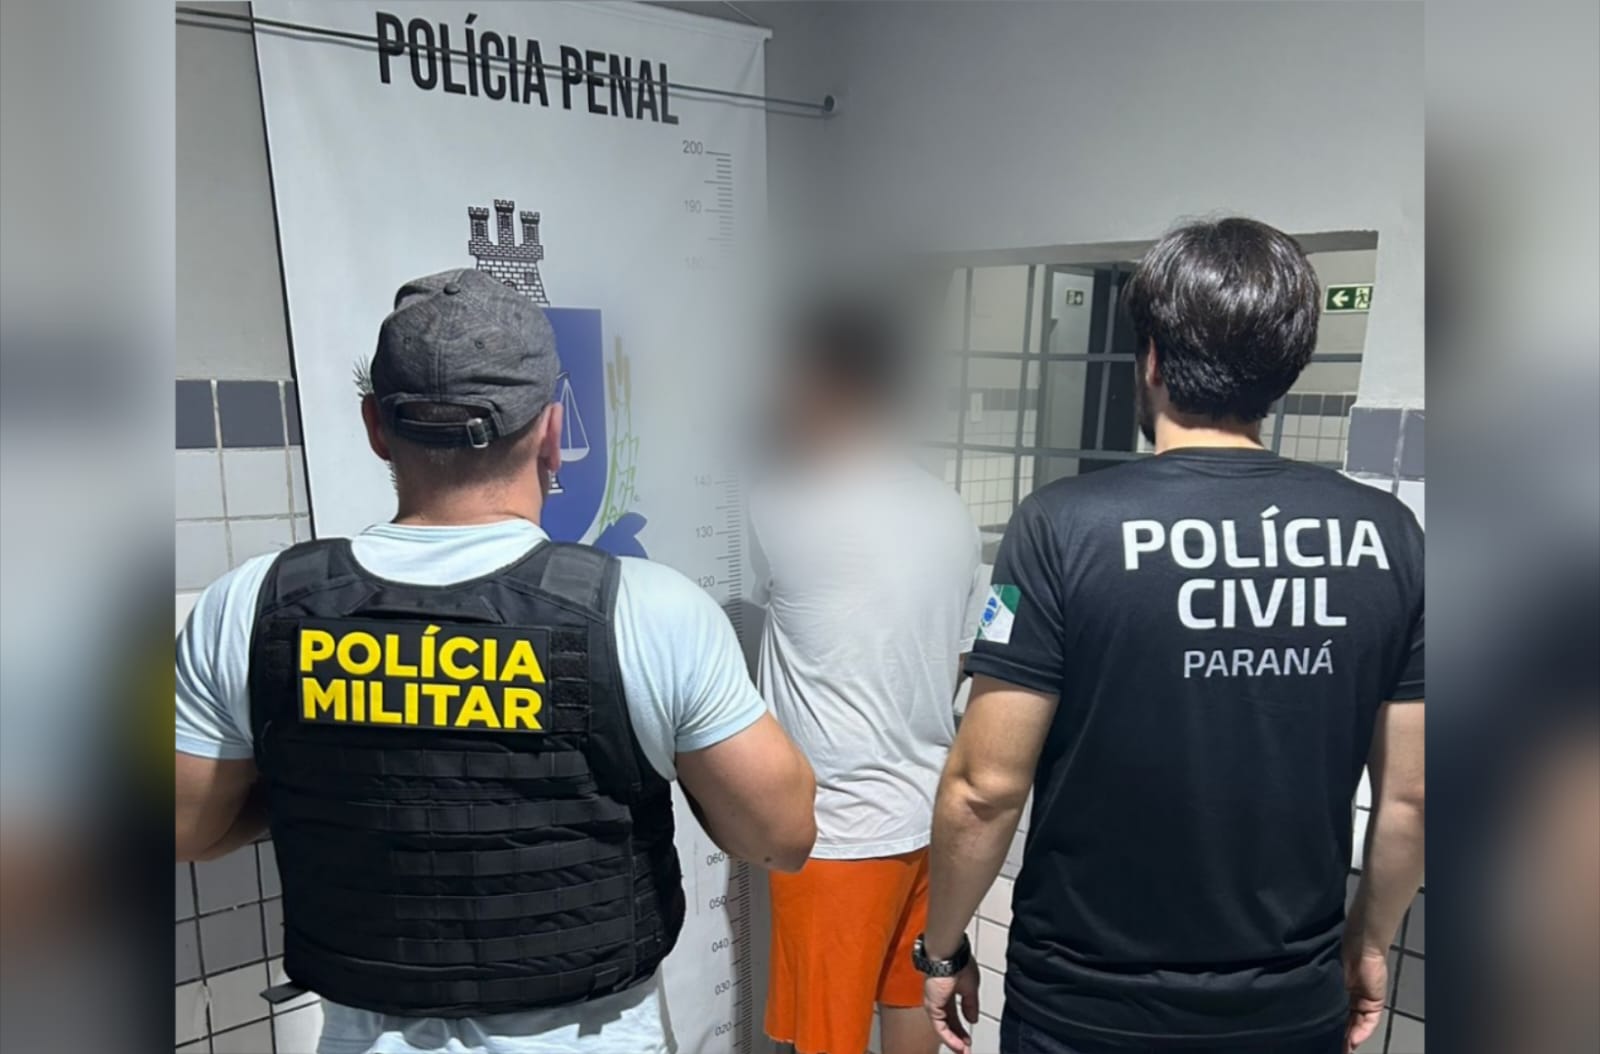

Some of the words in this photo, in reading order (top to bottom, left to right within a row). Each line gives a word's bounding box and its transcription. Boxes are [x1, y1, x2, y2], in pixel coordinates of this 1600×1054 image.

[375, 12, 549, 107] POLÍCIA
[560, 45, 679, 125] PENAL
[683, 140, 703, 154] 200
[684, 200, 702, 214] 190
[696, 526, 713, 538] 130
[1122, 505, 1390, 570] POLÍCIA
[697, 576, 715, 588] 120
[1177, 577, 1347, 629] CIVIL
[300, 624, 545, 683] POLÍCIA
[1183, 640, 1334, 678] PARANÁ
[302, 677, 543, 730] MILITAR
[706, 852, 725, 866] 060
[709, 895, 727, 910] 050
[712, 938, 729, 953] 040
[714, 980, 731, 996] 030
[715, 1022, 732, 1037] 020
